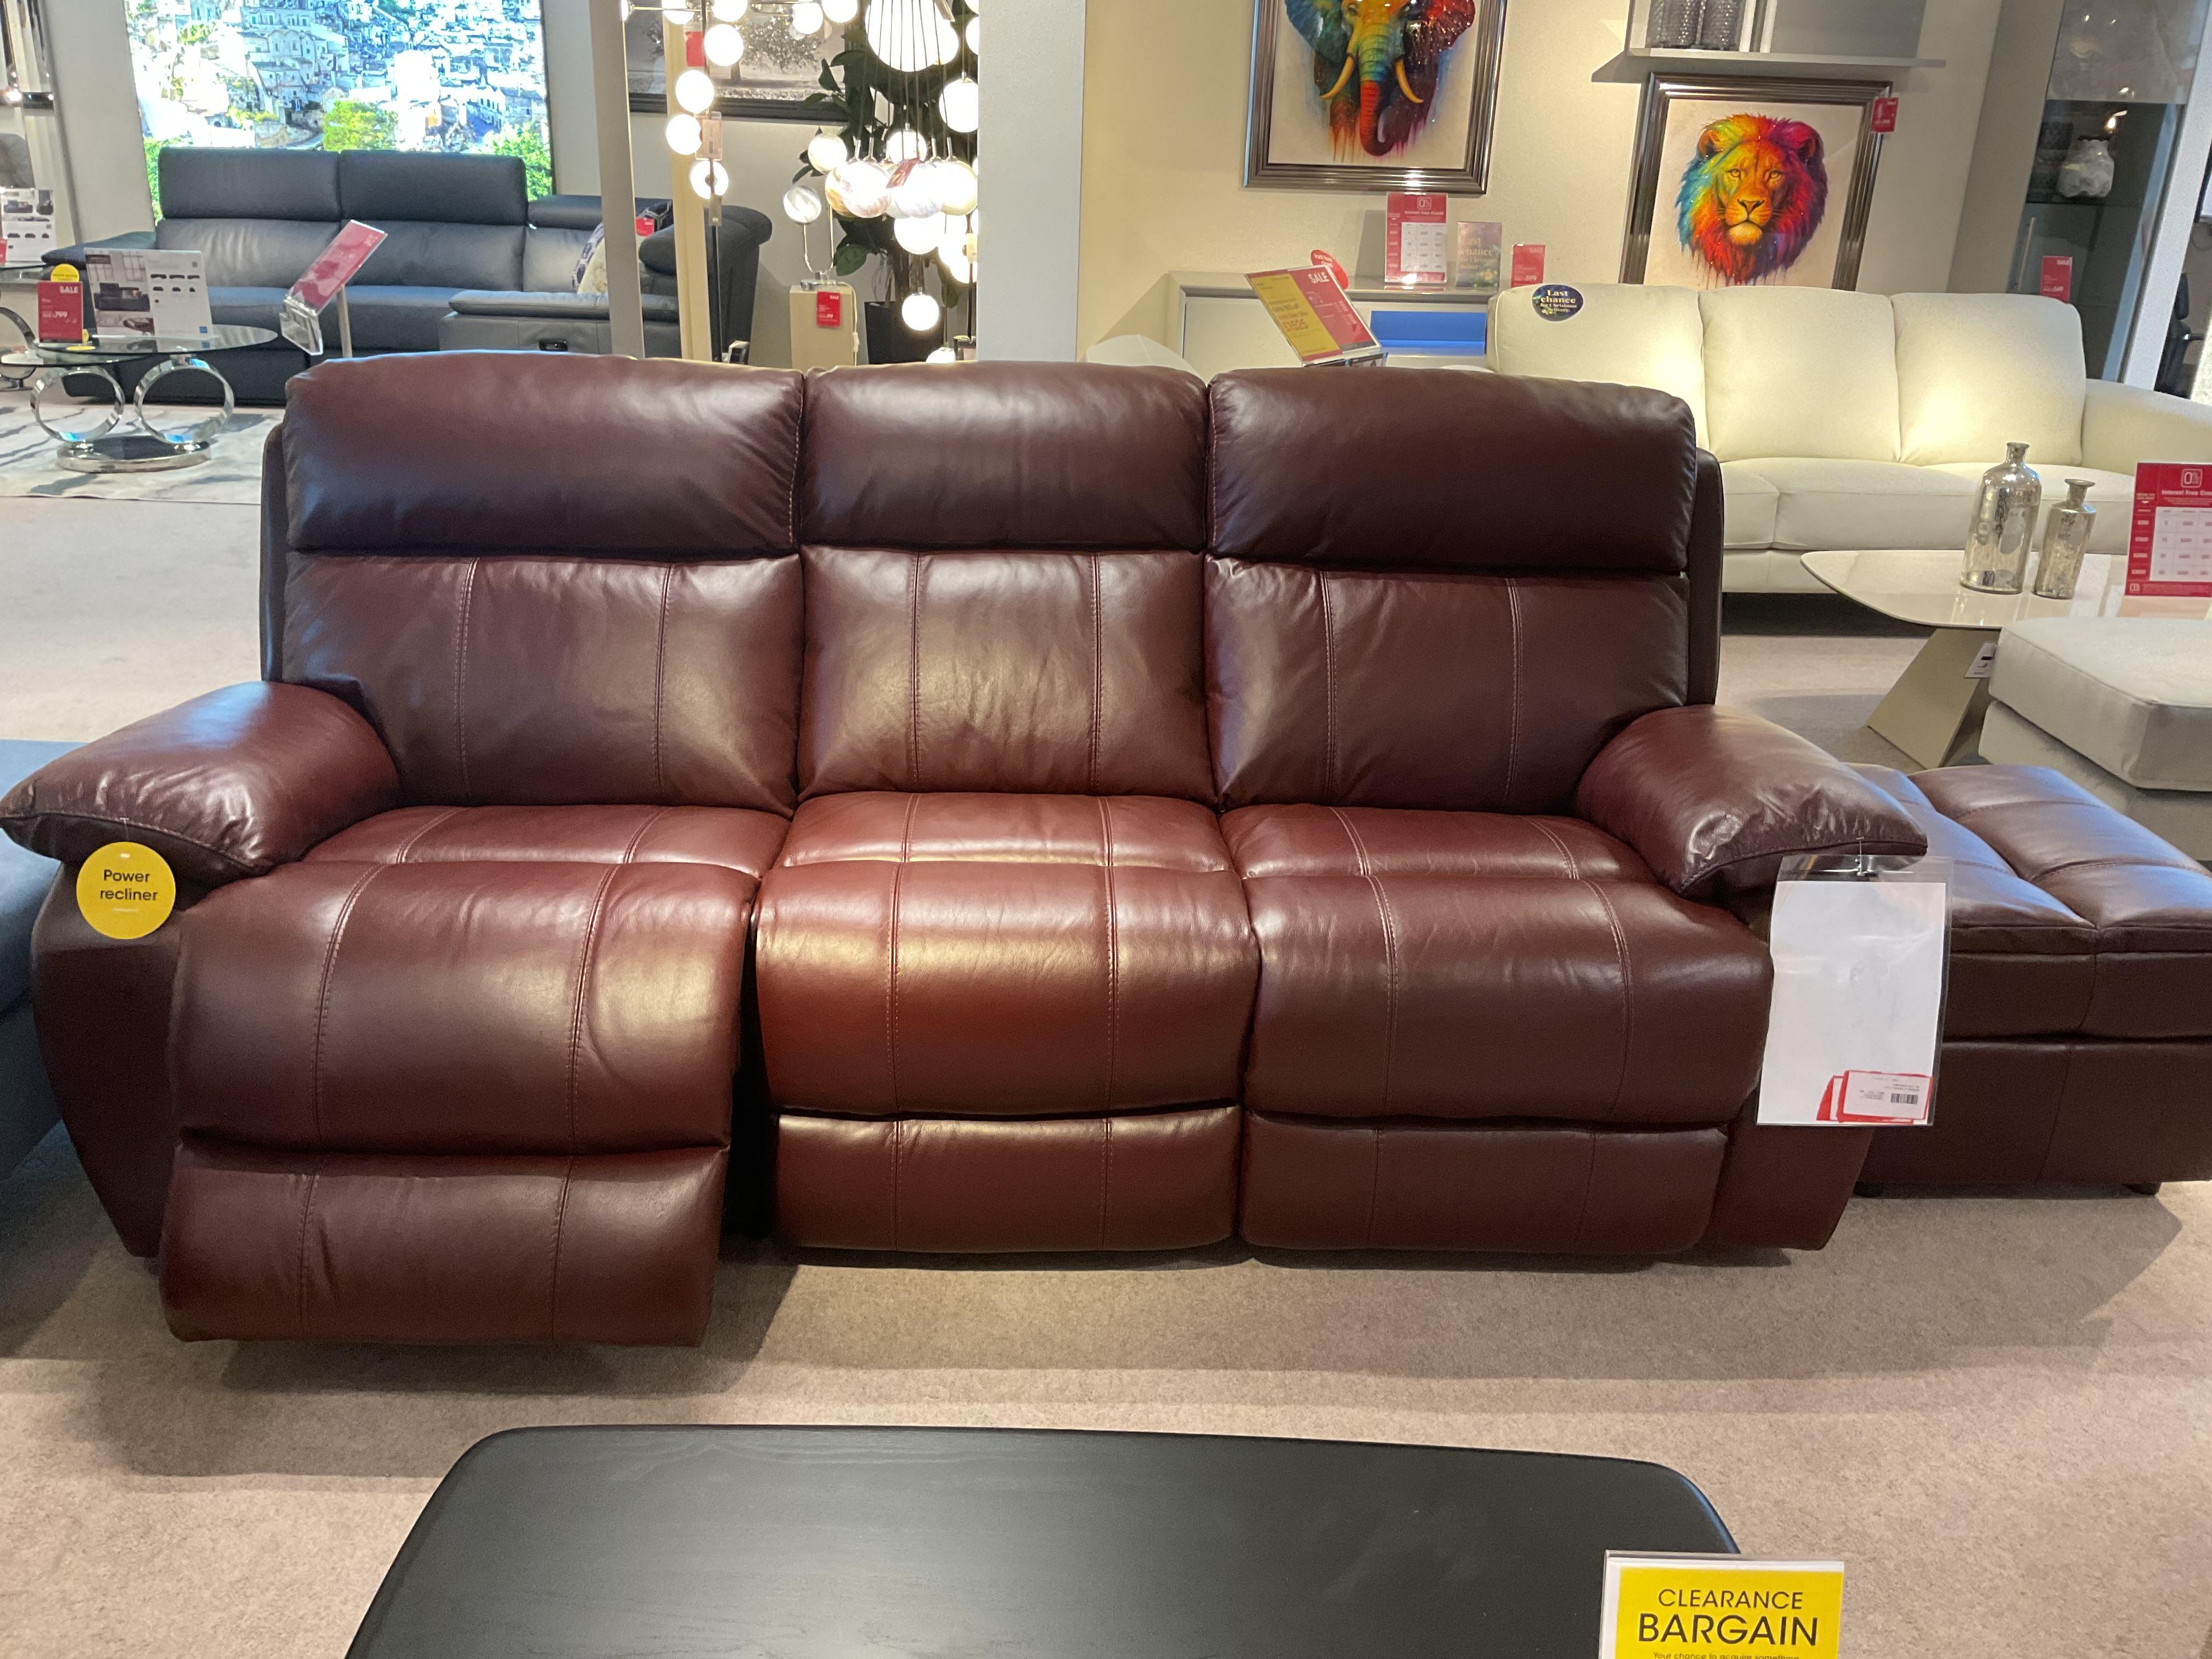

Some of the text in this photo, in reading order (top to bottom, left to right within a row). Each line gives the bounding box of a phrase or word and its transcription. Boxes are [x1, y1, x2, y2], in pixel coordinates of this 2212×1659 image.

[1308, 272, 1330, 284] SALE
[103, 869, 150, 883] Power
[100, 888, 158, 901] recliner
[1658, 1588, 1803, 1610] CLEARANCE
[1638, 1612, 1818, 1646] BARGAIN
